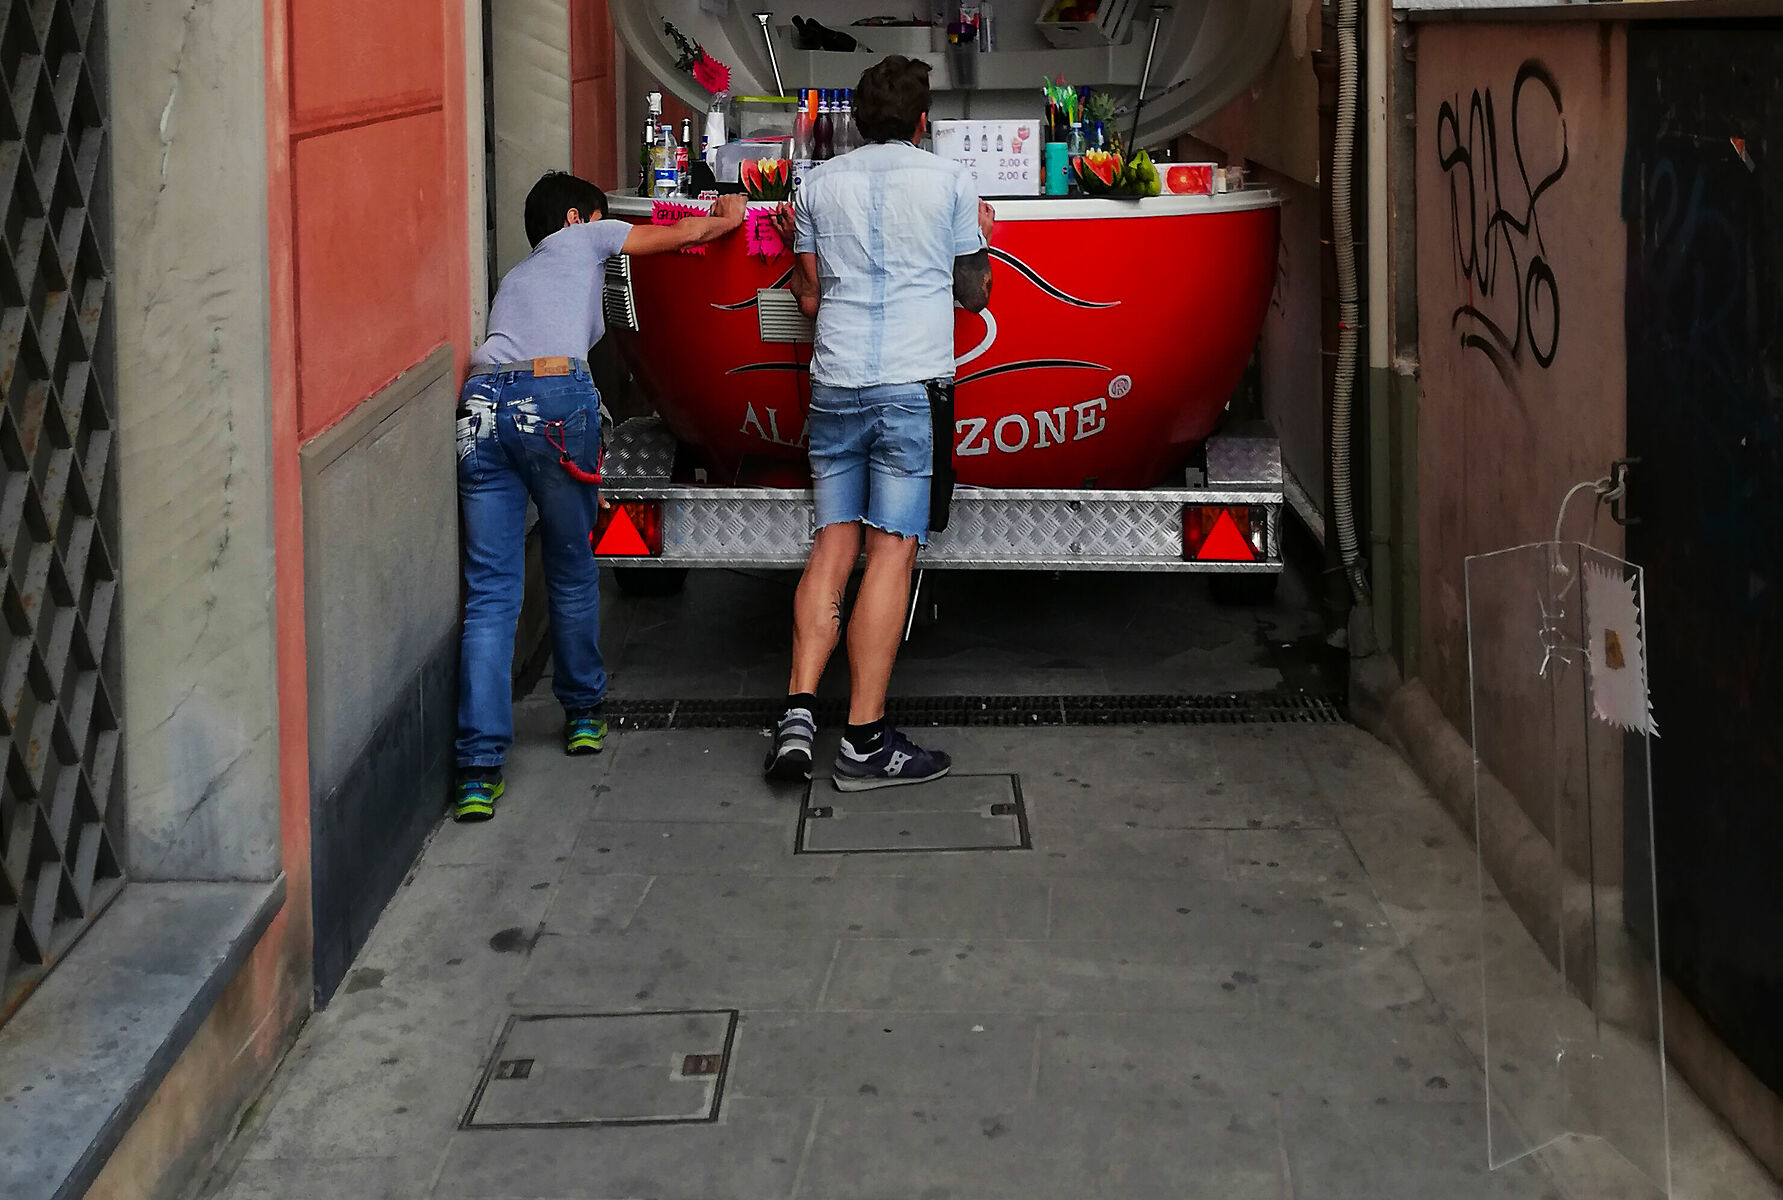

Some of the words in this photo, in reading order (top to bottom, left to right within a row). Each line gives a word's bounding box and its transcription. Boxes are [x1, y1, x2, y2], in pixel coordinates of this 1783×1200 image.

[999, 158, 1020, 167] 2,00
[998, 171, 1019, 181] 2,00
[1022, 171, 1028, 180] €
[955, 397, 1107, 456] ZONE
